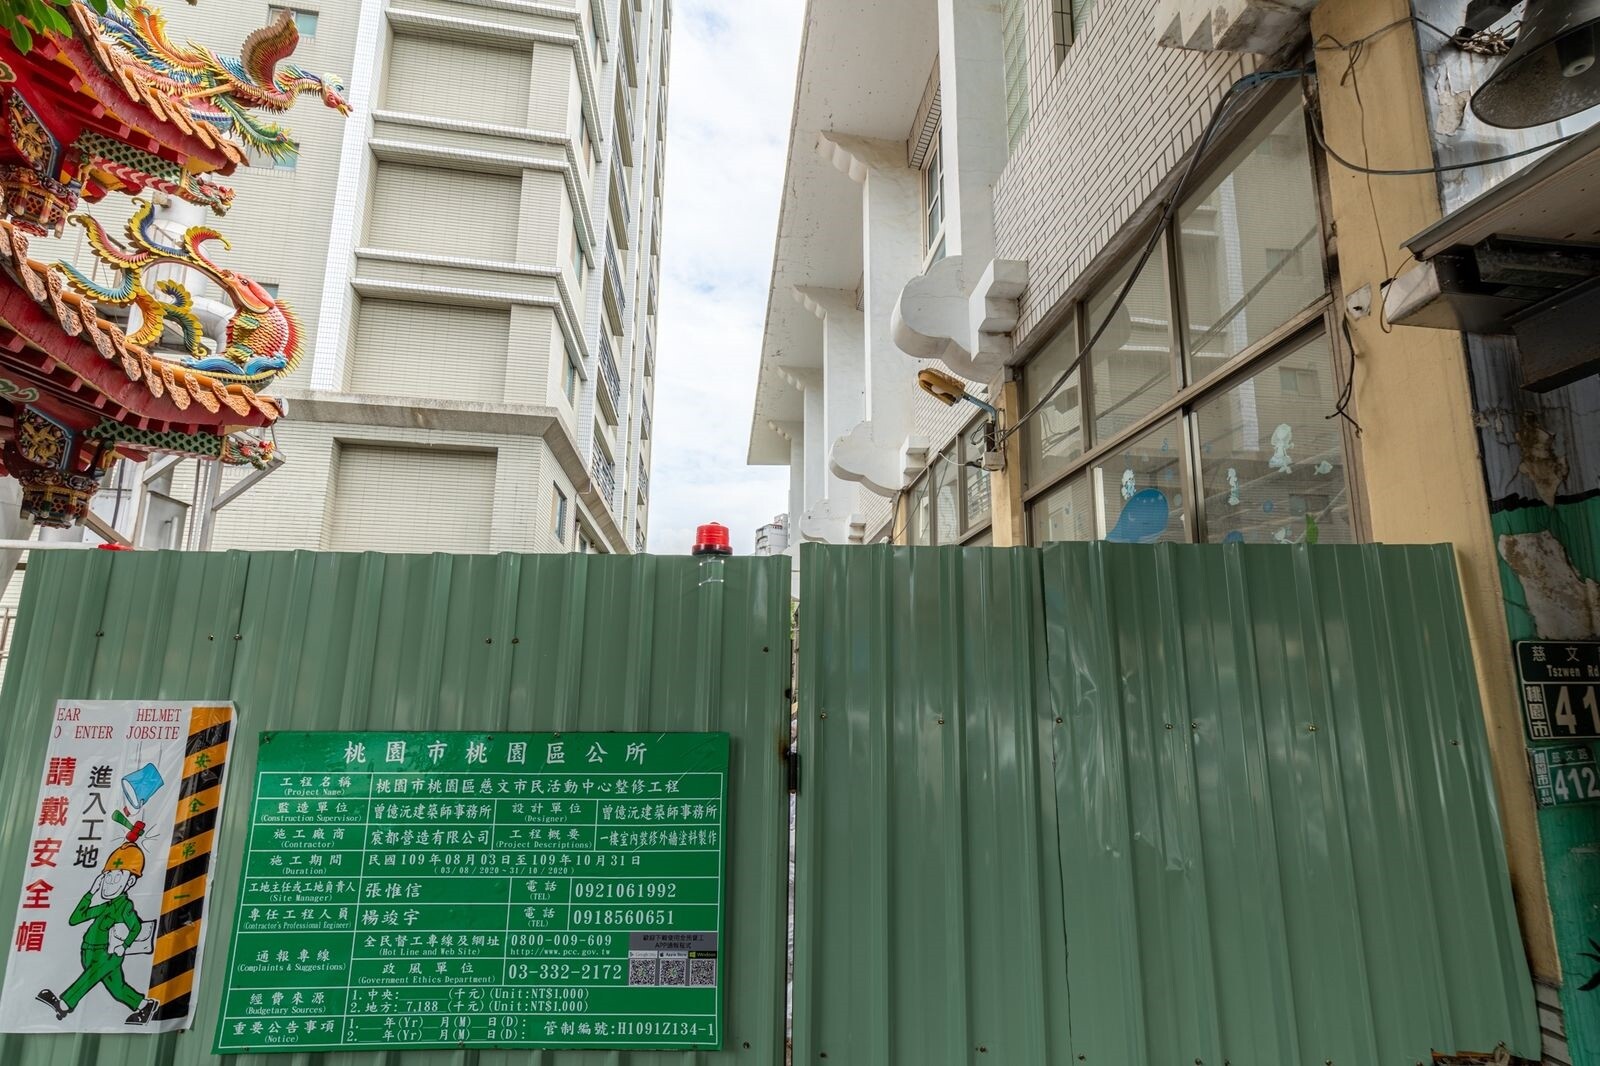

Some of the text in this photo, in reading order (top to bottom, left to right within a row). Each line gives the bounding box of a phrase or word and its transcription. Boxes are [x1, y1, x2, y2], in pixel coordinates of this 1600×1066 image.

[1546, 664, 1581, 677] Tszwen
[137, 708, 182, 722] HELMET
[1526, 685, 1549, 737] 桃園市
[75, 725, 114, 739] ENTER
[126, 726, 180, 740] JOBSITE
[343, 740, 648, 765] 桃園市桃園區公所
[280, 776, 352, 788] 工程名稱
[376, 778, 680, 795] 桃園市桃園區慈文市民活動中心整修工程
[1555, 767, 1600, 800] 412
[284, 788, 345, 797] (Project Name)
[277, 802, 348, 814] 監造單位
[512, 803, 582, 814] 設計單位
[73, 765, 113, 869] 進入工地
[261, 814, 362, 823] (Construction Supervisor)
[524, 815, 568, 824] (Designer)
[274, 828, 345, 840] 施工廠商
[509, 828, 580, 840] 工程概要
[281, 841, 335, 849] (Contractor)
[495, 841, 593, 850] (Project Descriptions)
[15, 757, 77, 953] 請戴安全帽
[270, 854, 342, 866] 施工期間
[282, 867, 327, 875] (Duration)
[249, 881, 356, 893] 工地主任或工地負責人
[526, 880, 557, 892] 電話
[575, 883, 676, 898] 0921061992
[269, 894, 332, 902] (Site Manager)
[248, 908, 348, 921] 專任工程人員
[524, 906, 555, 919] 電話
[573, 910, 674, 925] 0918560651
[364, 934, 500, 947] 全民督工專線及網址
[511, 934, 612, 946] 0800-009-609
[256, 949, 331, 962] 通報專線
[400, 948, 418, 956] Line
[458, 948, 480, 956] Site)
[237, 964, 284, 972] (Complaints
[294, 963, 346, 972] Suggestions)
[382, 962, 474, 975] 政風單位
[508, 964, 622, 980] 03-332-2172
[412, 976, 441, 984] Ethics
[444, 976, 496, 985] Department)
[250, 992, 325, 1005] 經費來源
[245, 1006, 326, 1015] (Budgetary Sources)
[233, 1019, 335, 1036] 重要公告事項
[264, 1035, 299, 1043] (Notice)
